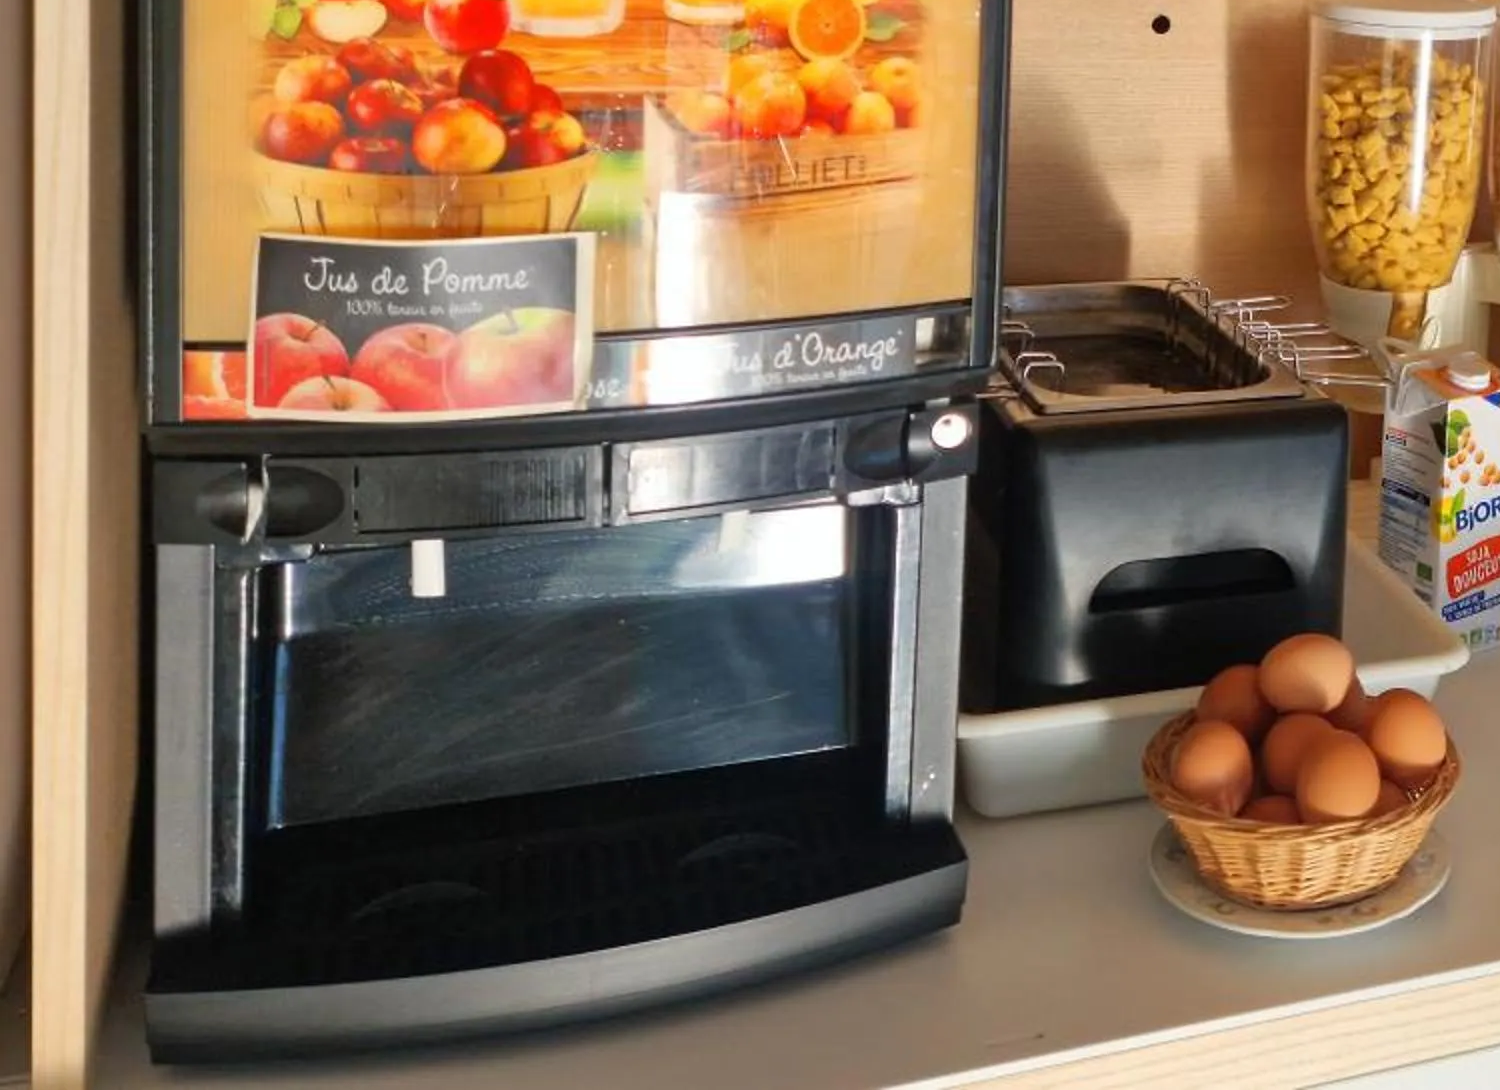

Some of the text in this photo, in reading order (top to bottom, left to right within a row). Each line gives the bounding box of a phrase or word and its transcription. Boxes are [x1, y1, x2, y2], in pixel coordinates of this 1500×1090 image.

[303, 255, 530, 295] Jus de Pomme
[773, 331, 900, 372] d'Orange
